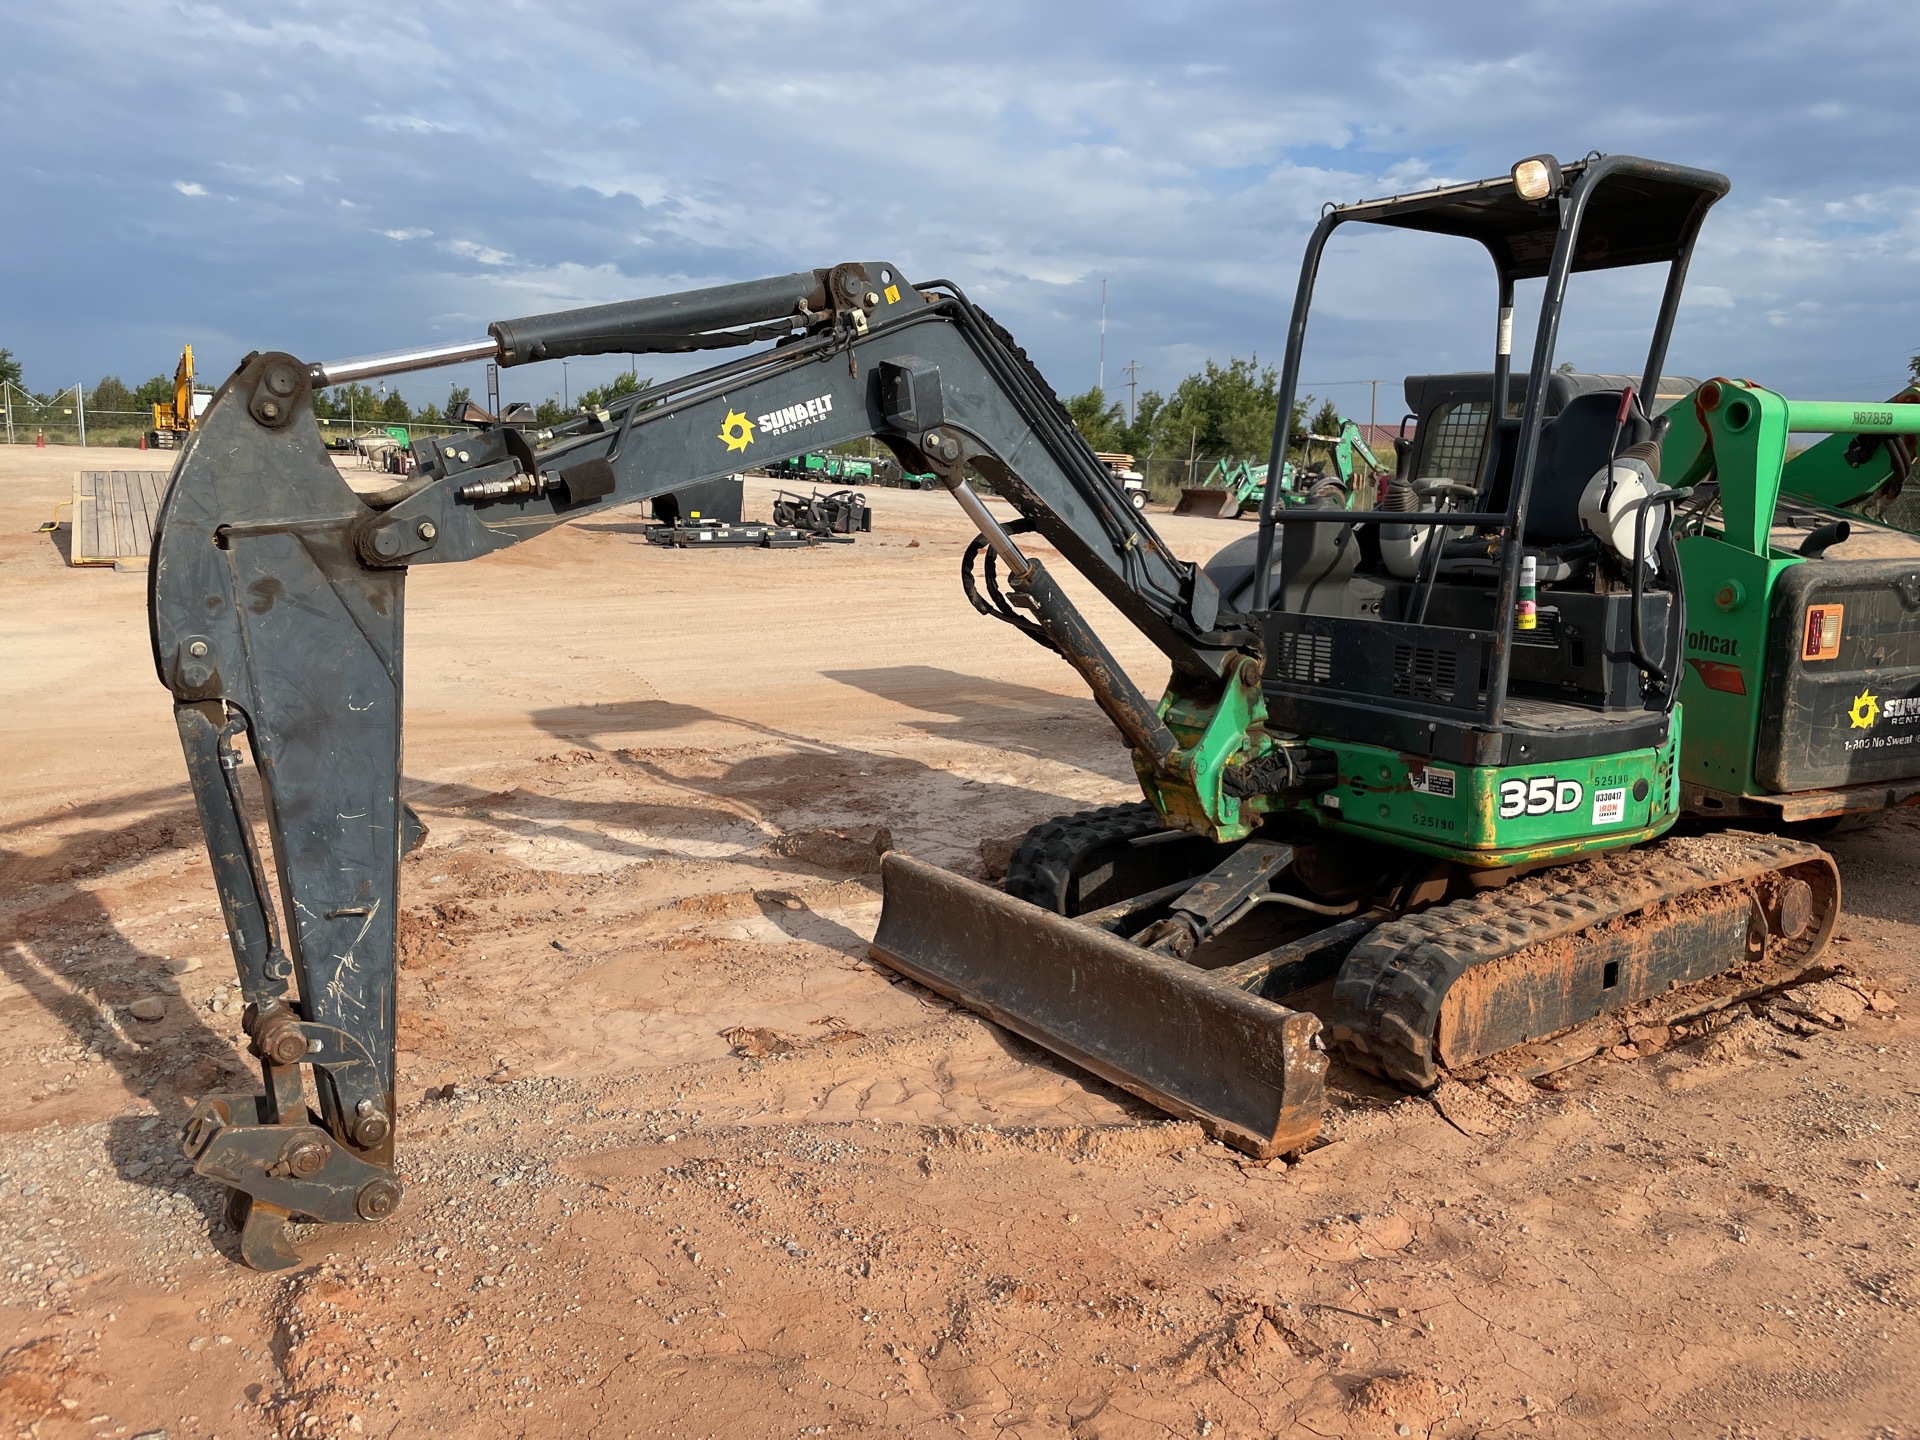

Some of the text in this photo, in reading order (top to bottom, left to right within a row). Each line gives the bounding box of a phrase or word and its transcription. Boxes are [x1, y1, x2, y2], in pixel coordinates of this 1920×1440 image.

[758, 394, 833, 433] SUNBELT
[1853, 412, 1892, 425] 967858
[773, 414, 826, 436] RENTALS
[1685, 626, 1737, 656] obcat
[1872, 736, 1885, 748] No
[1886, 734, 1914, 747] Sweat
[1594, 774, 1629, 787] 525190
[1499, 775, 1584, 819] 35D
[1599, 803, 1618, 813] IRON
[1412, 813, 1455, 831] 525190
